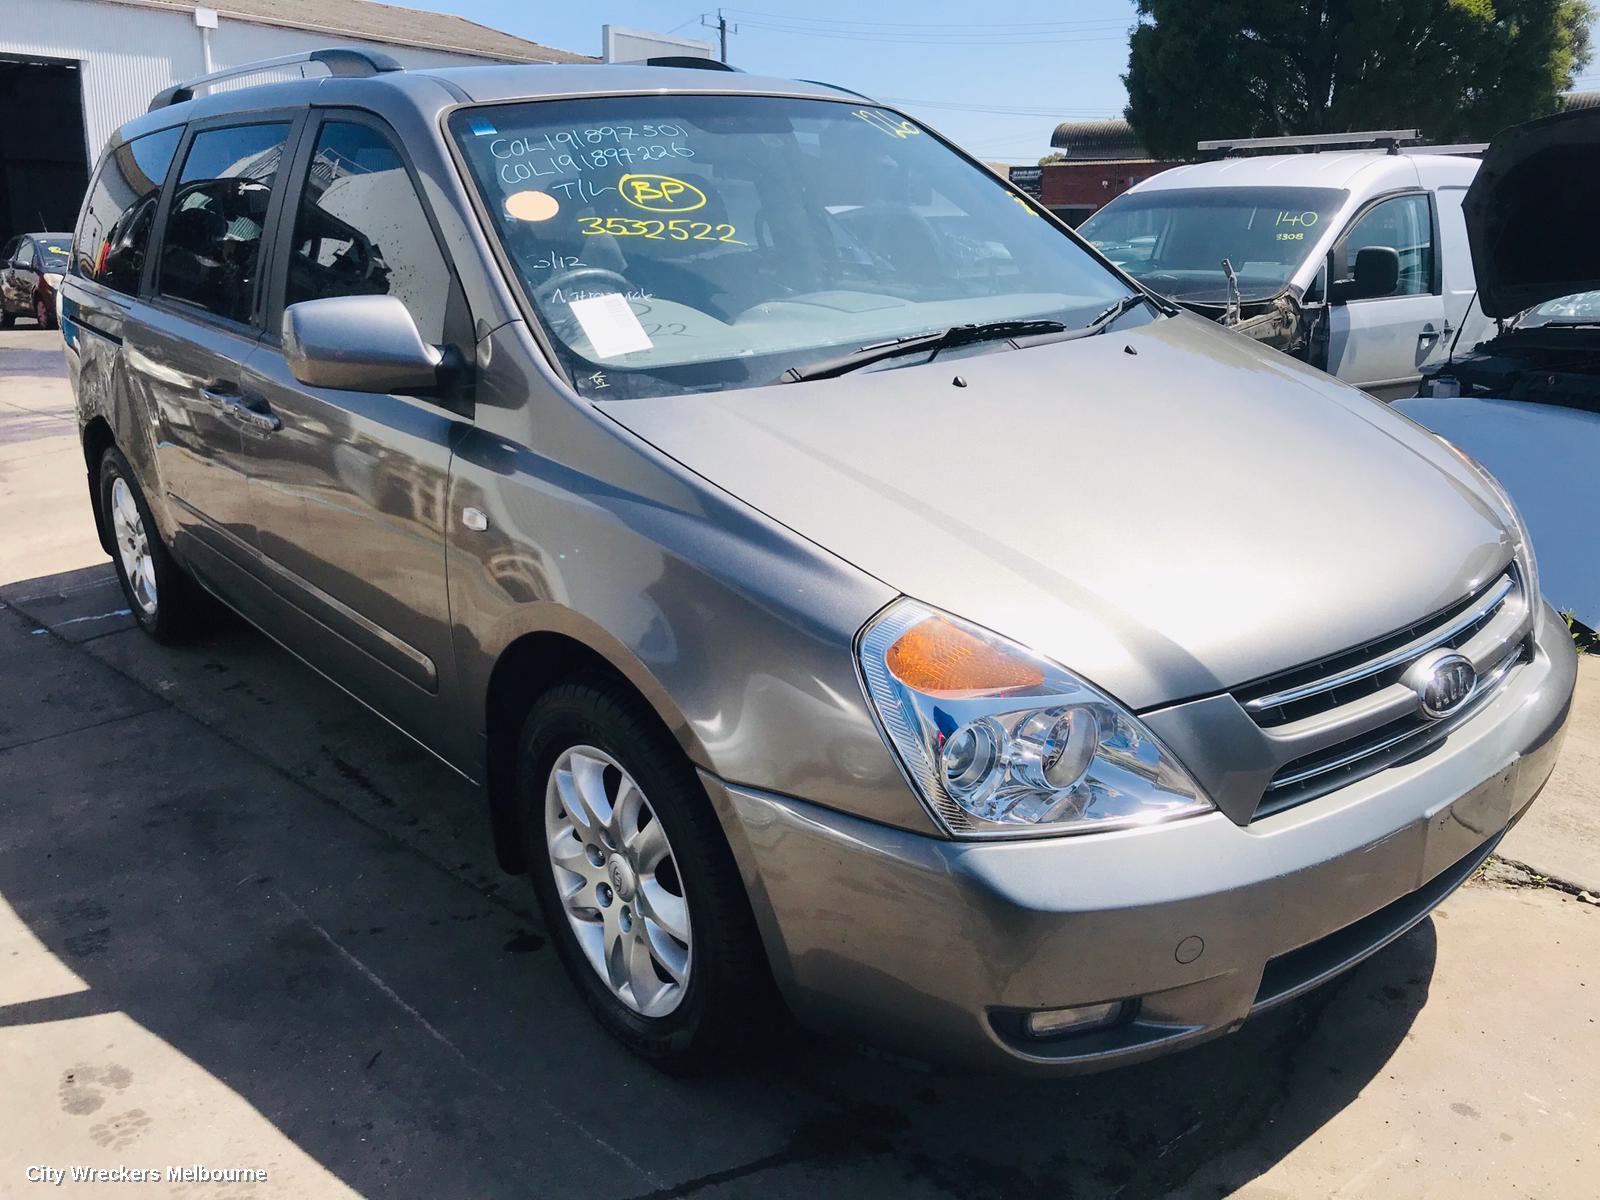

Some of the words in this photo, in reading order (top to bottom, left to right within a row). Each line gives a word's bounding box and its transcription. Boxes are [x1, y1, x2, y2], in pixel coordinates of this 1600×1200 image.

[630, 181, 685, 204] BP
[1275, 211, 1319, 227] 140
[577, 217, 749, 246] 3532522
